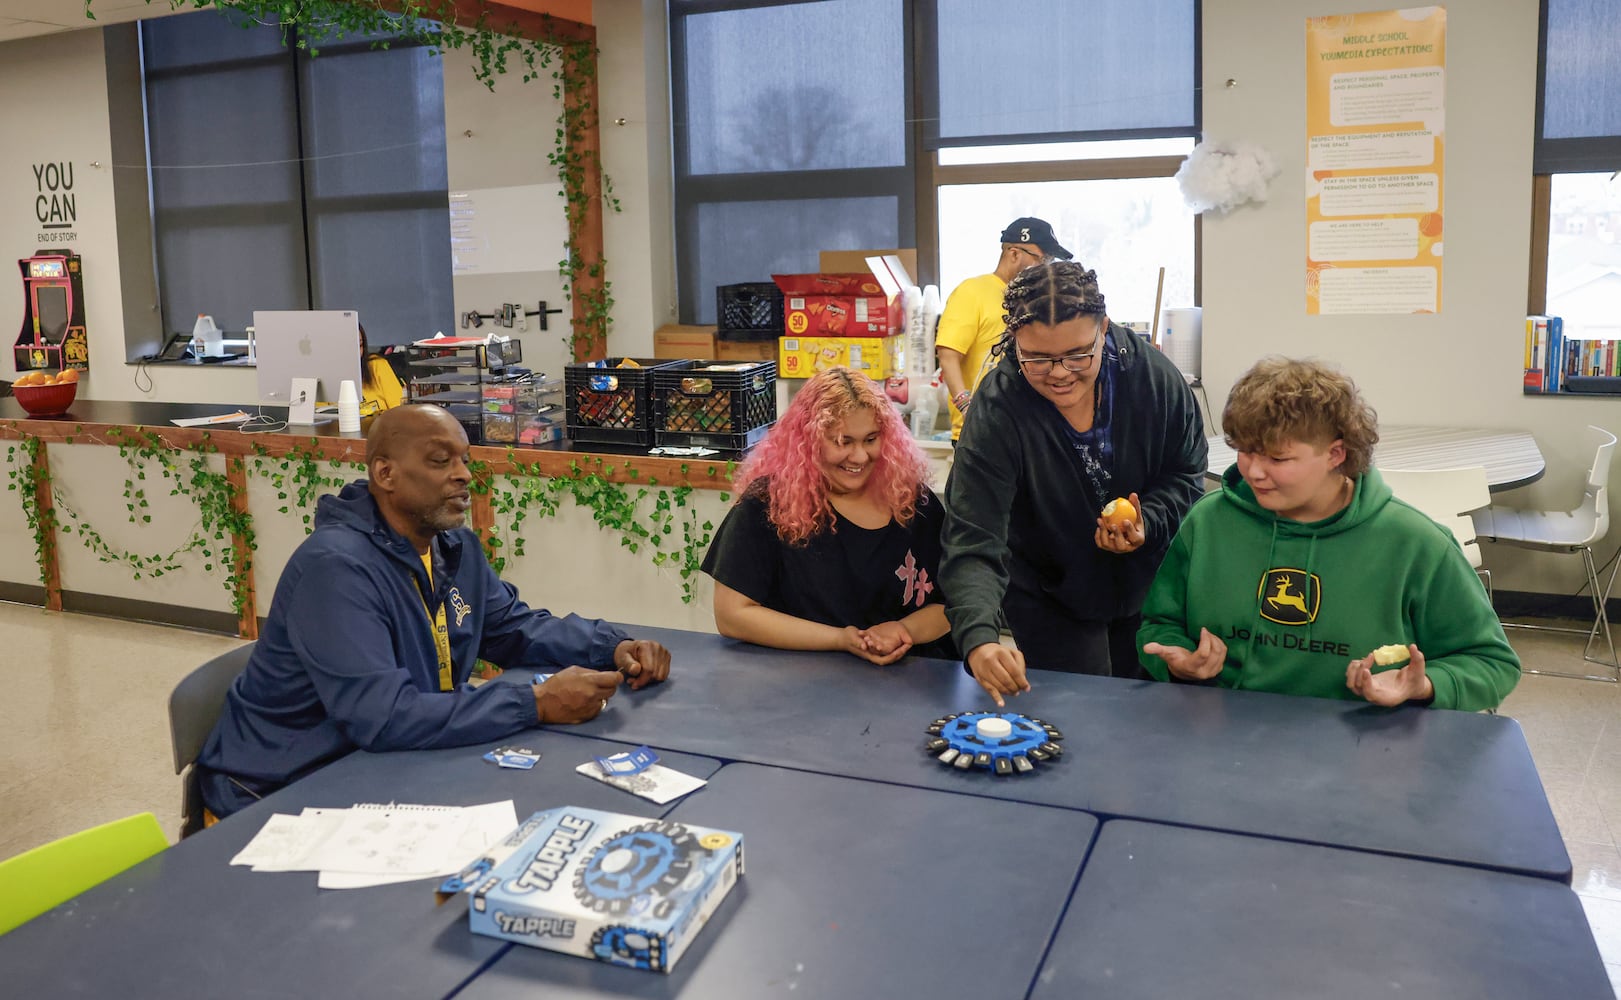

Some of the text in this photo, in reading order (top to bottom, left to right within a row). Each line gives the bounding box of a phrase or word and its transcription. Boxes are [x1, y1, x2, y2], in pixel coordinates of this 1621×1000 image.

[1342, 32, 1409, 45] MIDDLE SCHOOL
[1365, 44, 1433, 58] EXPECTATIONS
[32, 162, 73, 192] YOU
[36, 193, 76, 223] CAN
[38, 233, 77, 243] END OF STORY
[1020, 228, 1031, 242] 3
[792, 315, 803, 326] 50
[787, 356, 798, 367] 50
[517, 815, 595, 891] TAPPLE
[500, 915, 576, 938] TAPPLE
